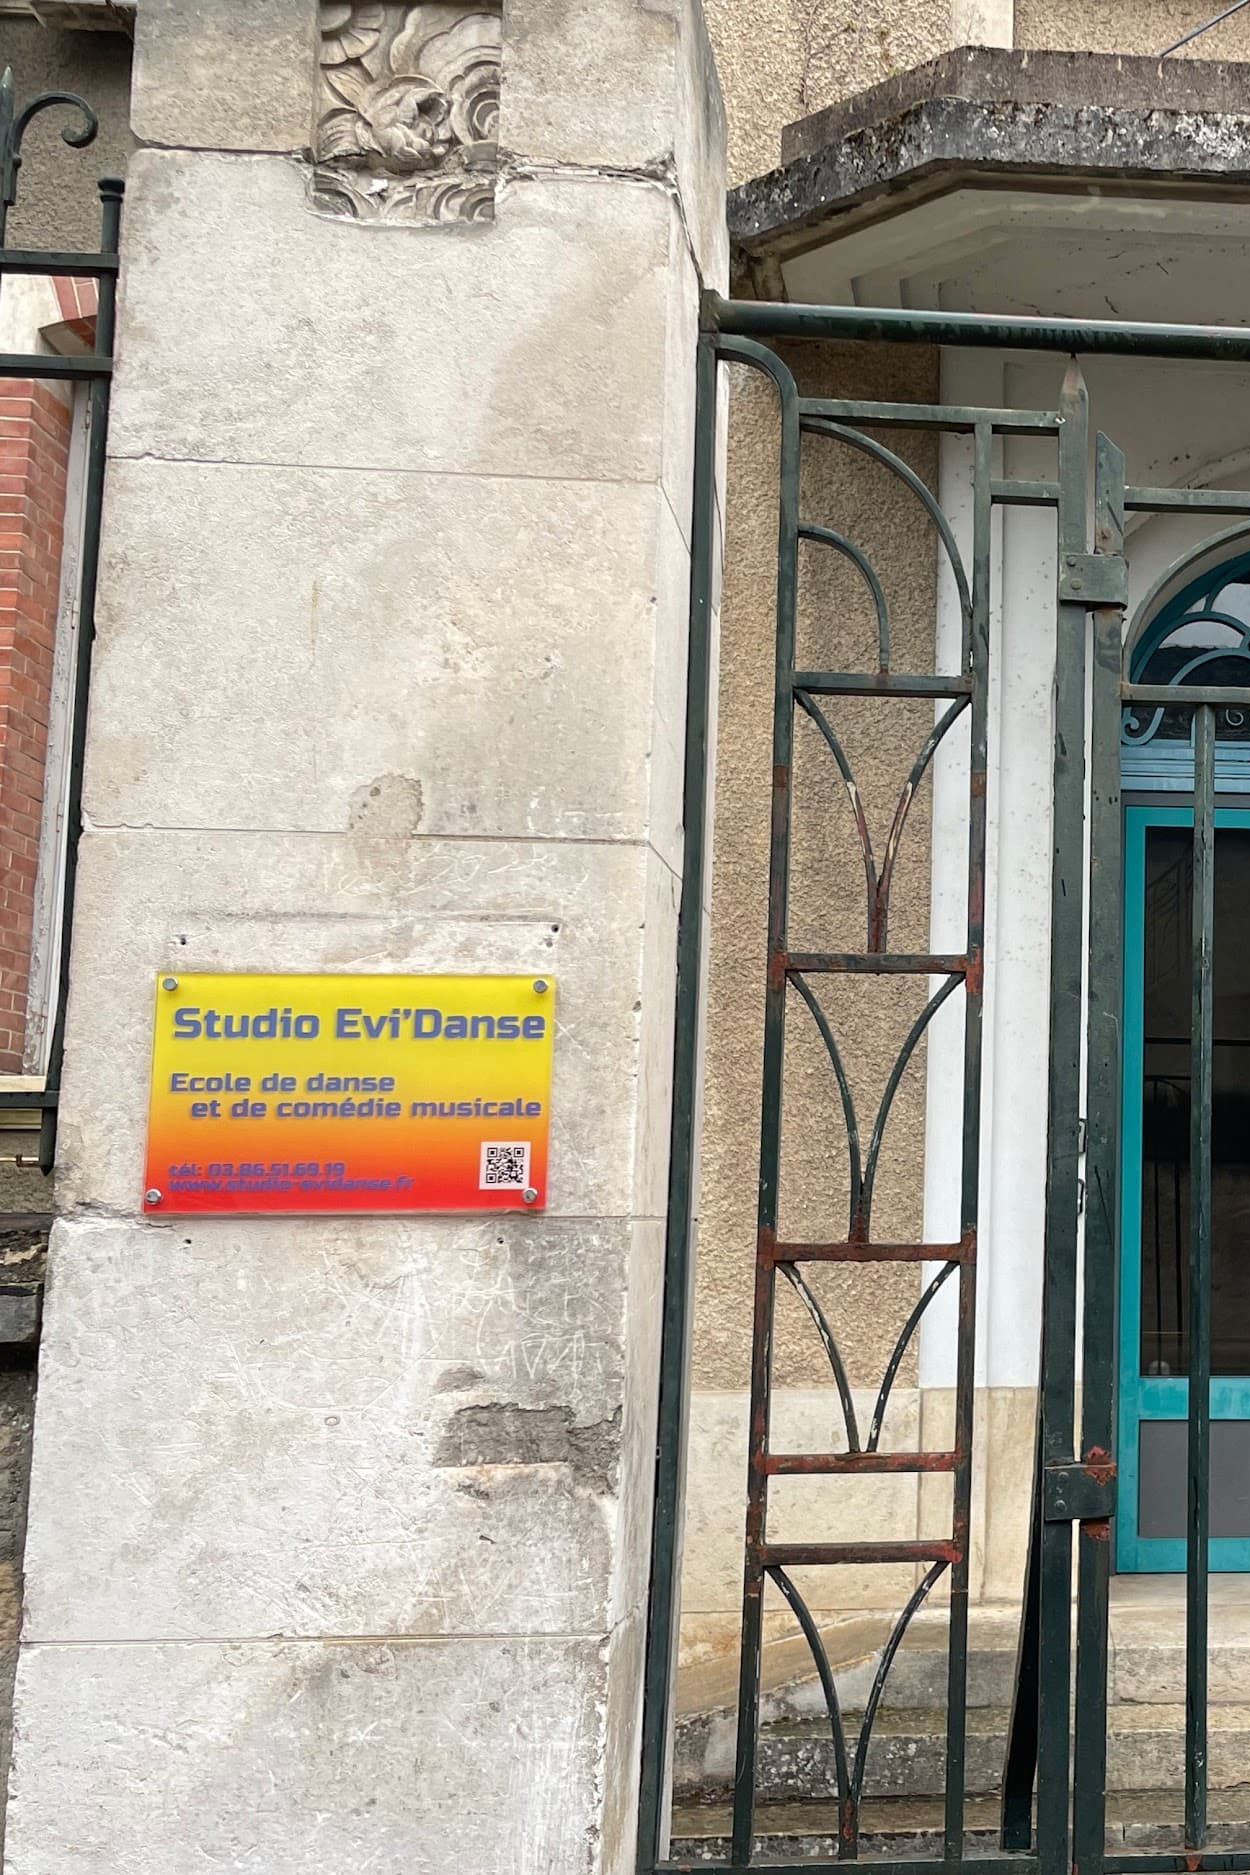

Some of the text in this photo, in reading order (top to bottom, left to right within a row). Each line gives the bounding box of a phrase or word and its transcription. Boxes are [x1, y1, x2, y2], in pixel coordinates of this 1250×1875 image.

[173, 1007, 320, 1039] Studio
[170, 1073, 395, 1092] Ecole de danse
[191, 1097, 542, 1118] et de comédie musicale
